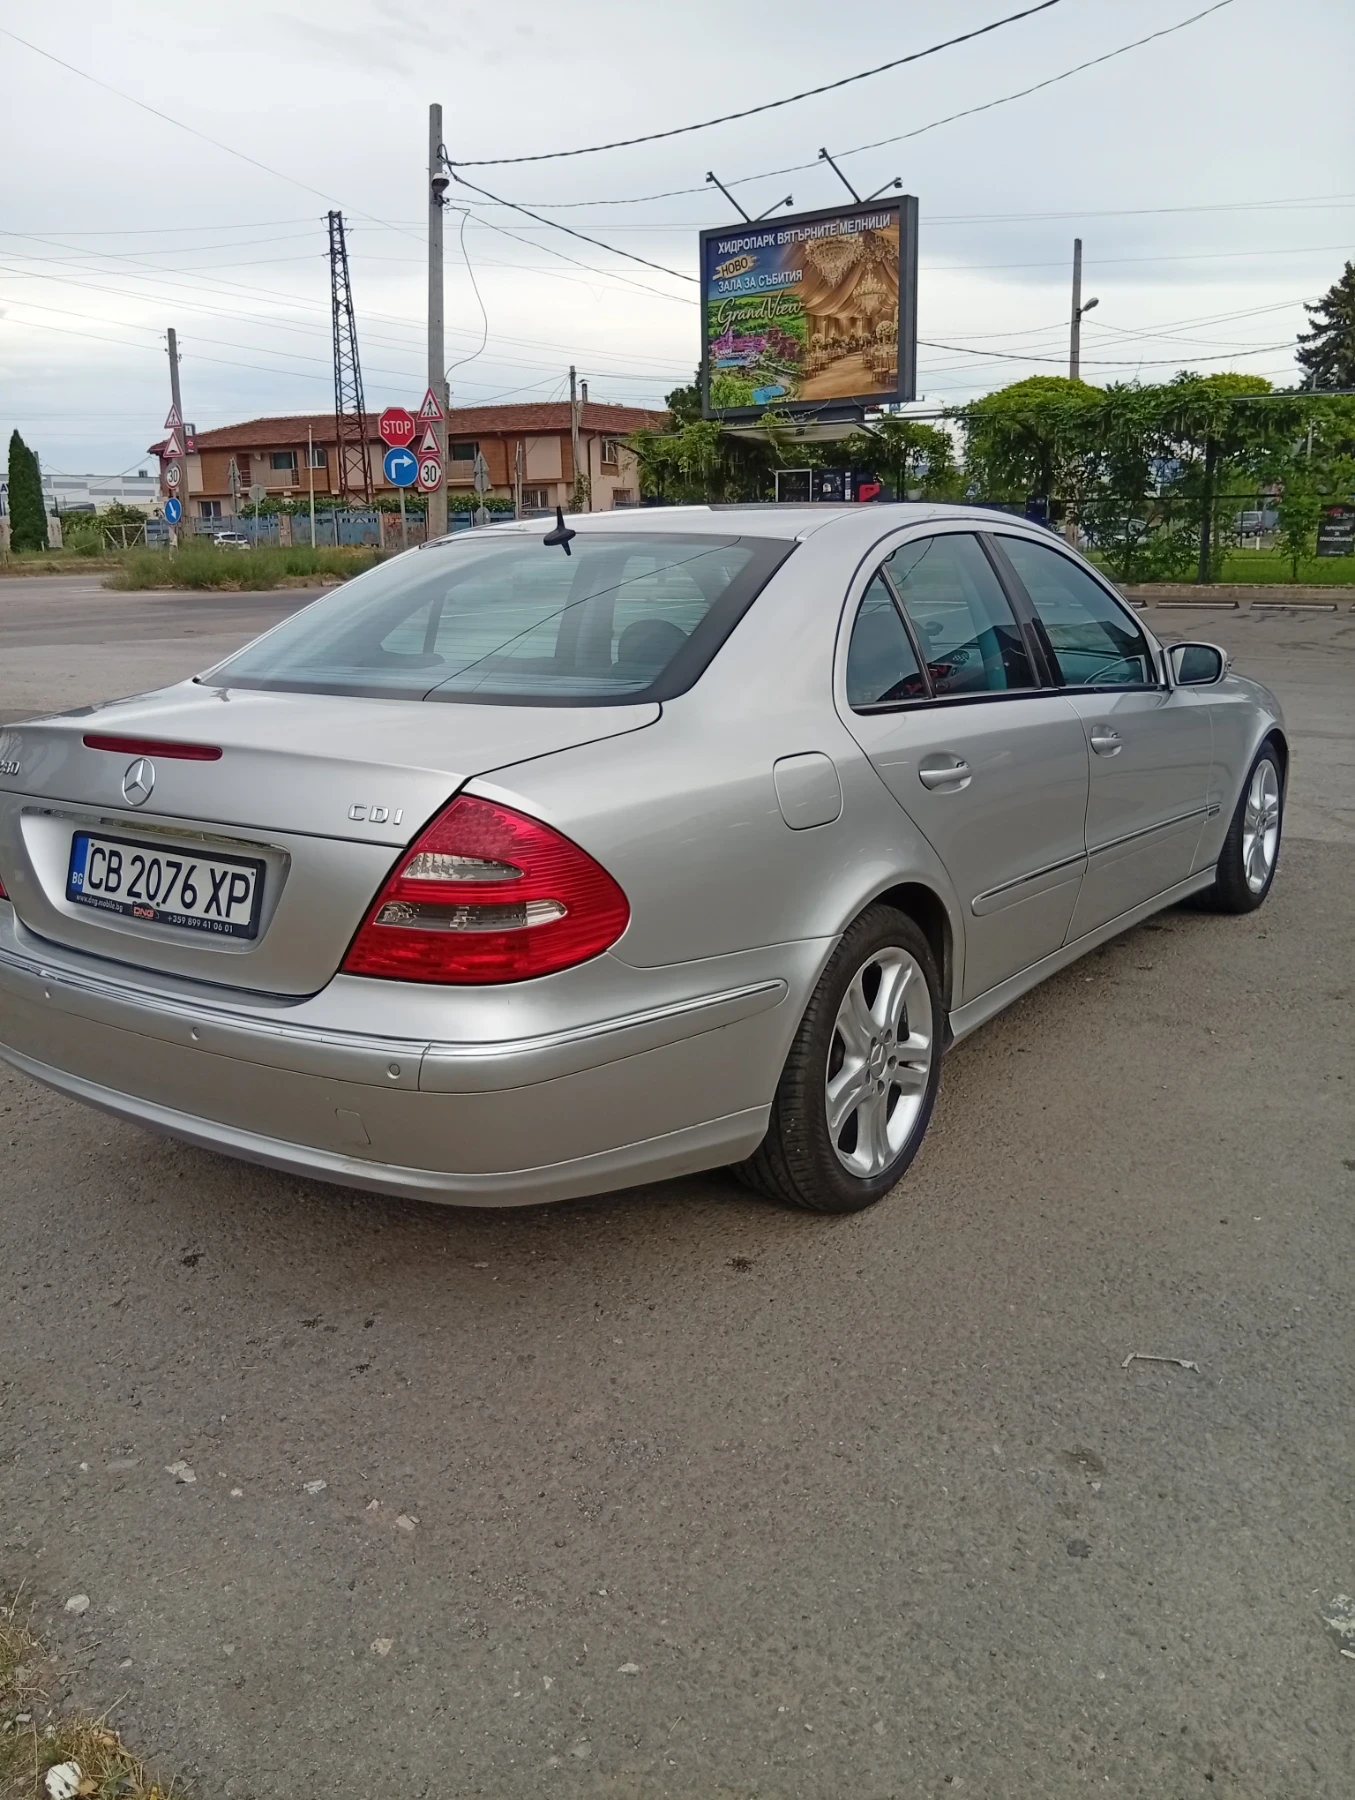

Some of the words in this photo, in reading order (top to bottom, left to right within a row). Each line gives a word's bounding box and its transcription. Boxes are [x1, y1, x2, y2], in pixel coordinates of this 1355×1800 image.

[717, 233, 776, 255] ХИДРОПАРК
[777, 223, 838, 244] ВЯТЪРНИТЕ
[839, 213, 891, 235] МЕЛНИЦИ
[721, 257, 748, 277] НОВО
[718, 277, 743, 293] ЗАЛА
[744, 275, 756, 288] ЗА
[758, 270, 803, 286] СЪБИТИЯ
[382, 420, 411, 435] STOP
[168, 469, 178, 483] 30
[423, 465, 437, 482] 30
[348, 803, 404, 826] CDI
[72, 871, 84, 885] BG
[88, 847, 123, 893] CB
[126, 854, 198, 910] 2076
[203, 867, 250, 919] XP
[76, 894, 124, 913] www.dng.mobile.bg
[133, 905, 155, 918] DNG
[167, 915, 186, 925] +359
[187, 917, 201, 927] 899
[202, 919, 211, 929] 41
[213, 921, 223, 931] 06
[224, 923, 233, 933] 01
